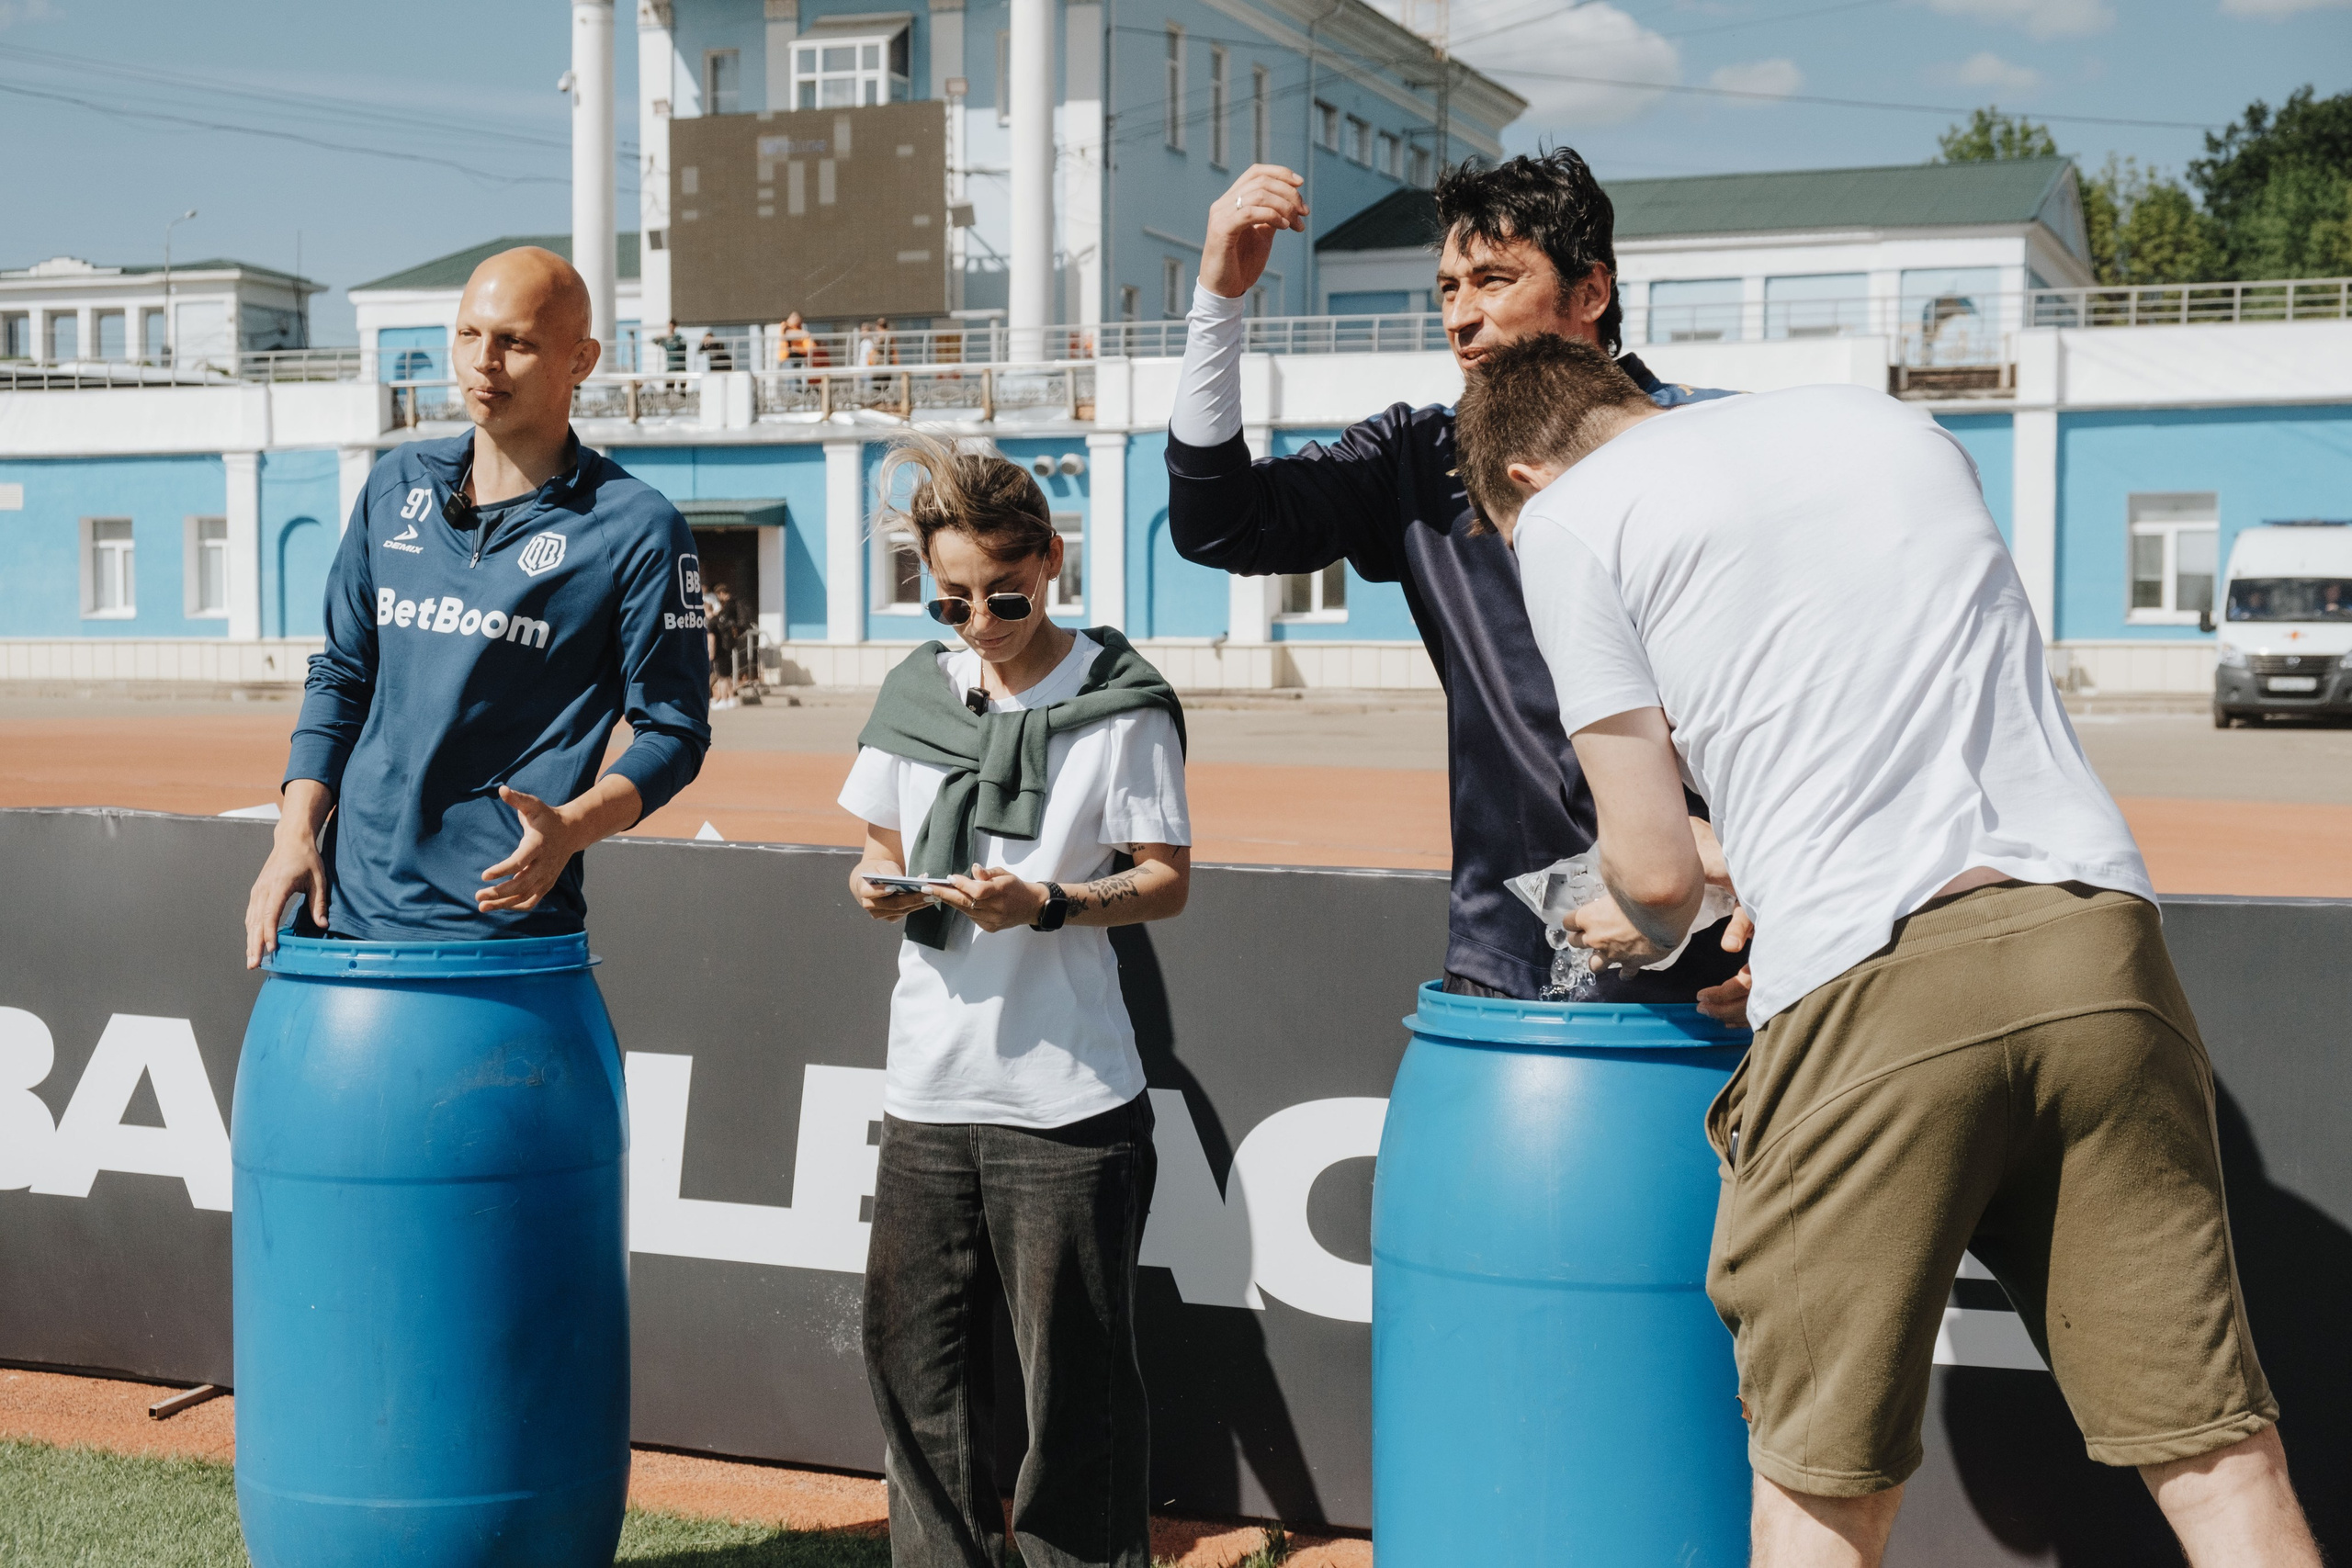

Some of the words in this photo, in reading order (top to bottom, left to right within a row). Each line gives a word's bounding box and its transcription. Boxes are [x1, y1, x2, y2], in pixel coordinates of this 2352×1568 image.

[382, 539, 424, 555] DEMIX
[685, 570, 701, 593] BB
[377, 587, 550, 649] BetBoom
